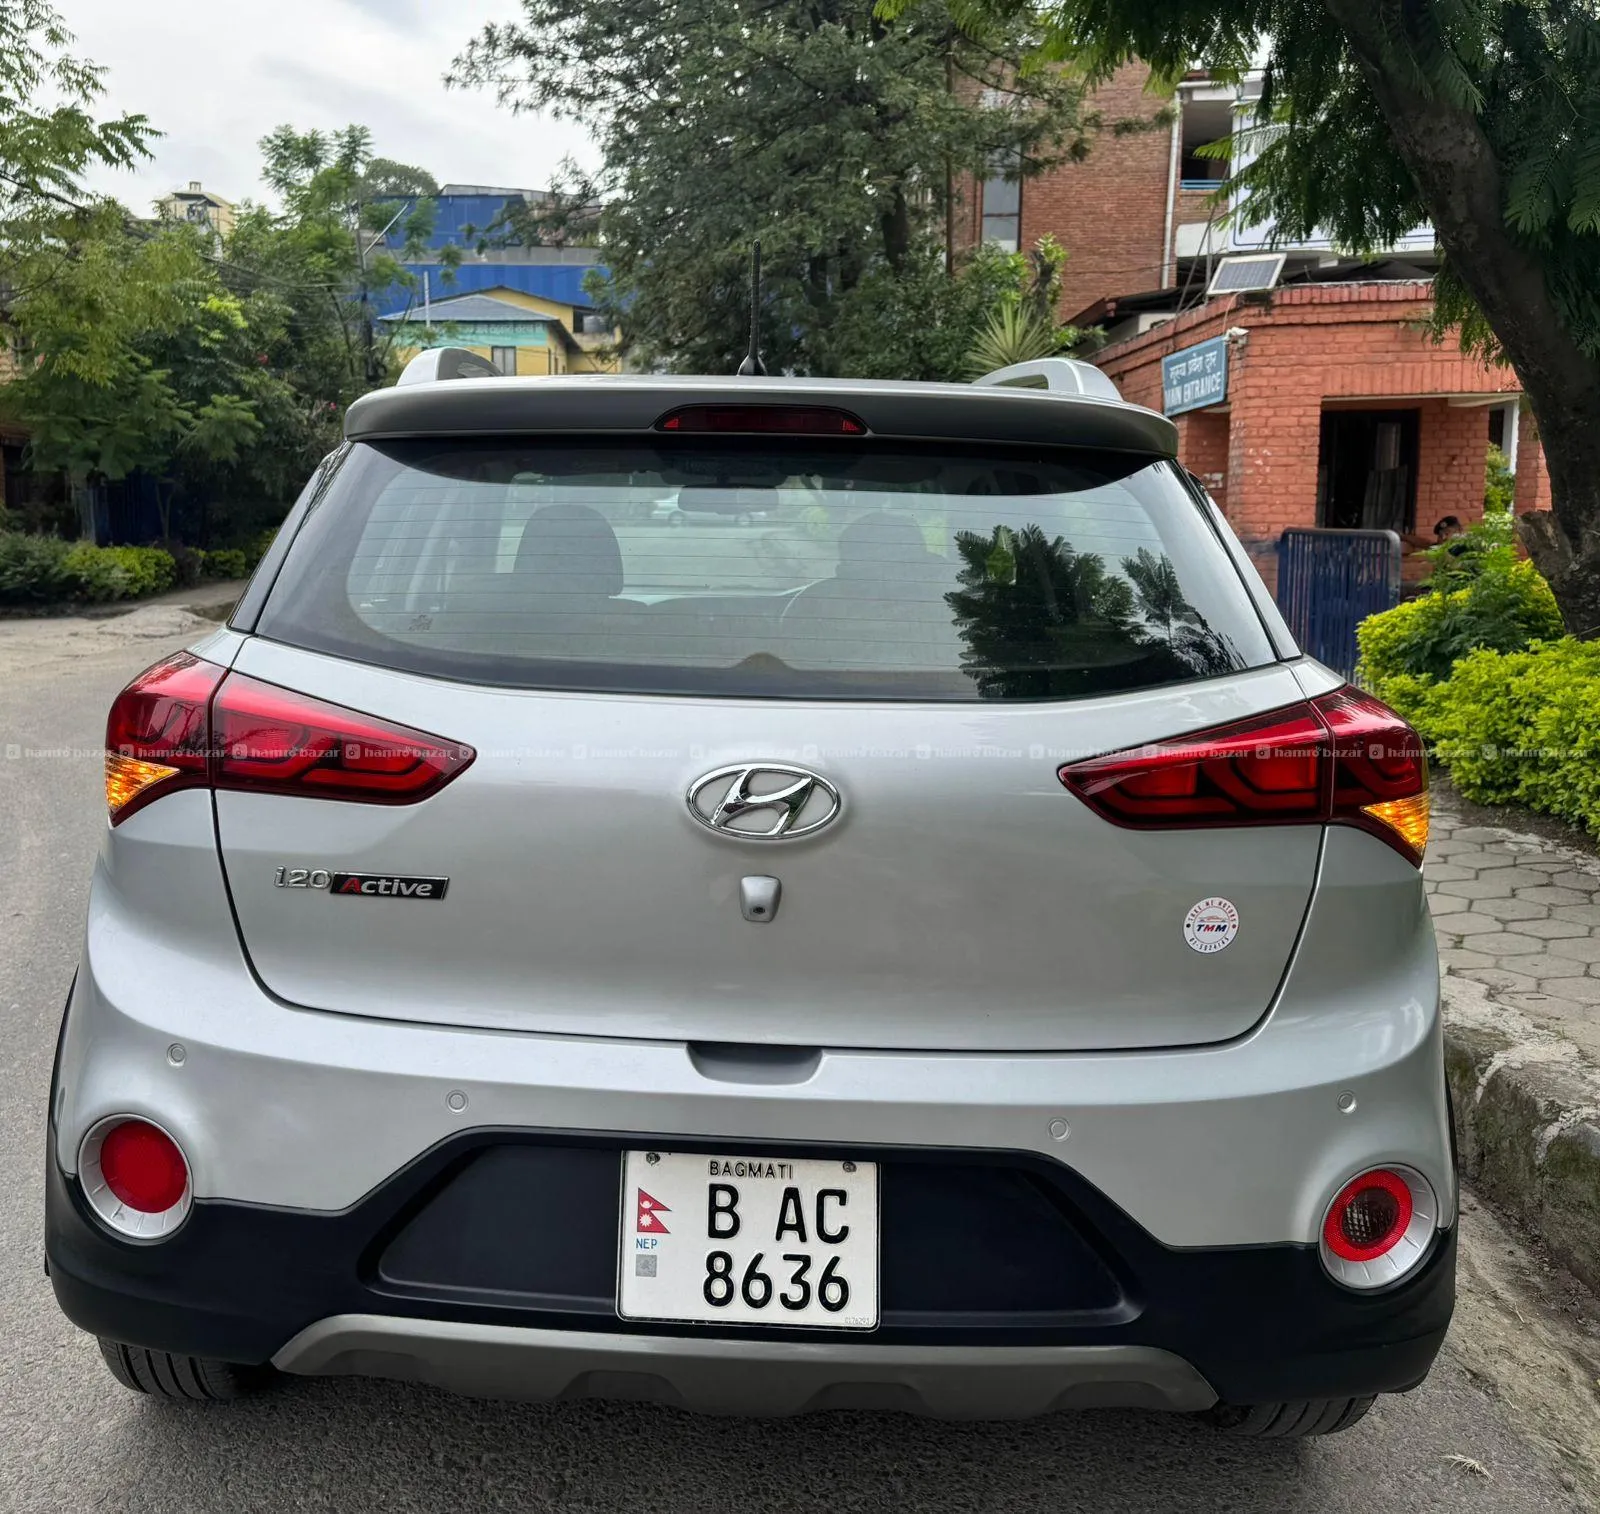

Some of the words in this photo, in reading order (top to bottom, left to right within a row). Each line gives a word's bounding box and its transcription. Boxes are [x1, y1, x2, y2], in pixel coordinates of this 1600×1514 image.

[1165, 386, 1182, 408] MAIN
[1183, 371, 1222, 404] ENTRANCE
[274, 866, 332, 888] i20
[339, 877, 433, 896] Active
[1196, 924, 1228, 932] TMM
[709, 1160, 793, 1180] BAGMATI
[707, 1183, 741, 1239] B
[775, 1187, 849, 1244] AC
[635, 1238, 658, 1249] NEP
[703, 1250, 850, 1312] 8636
